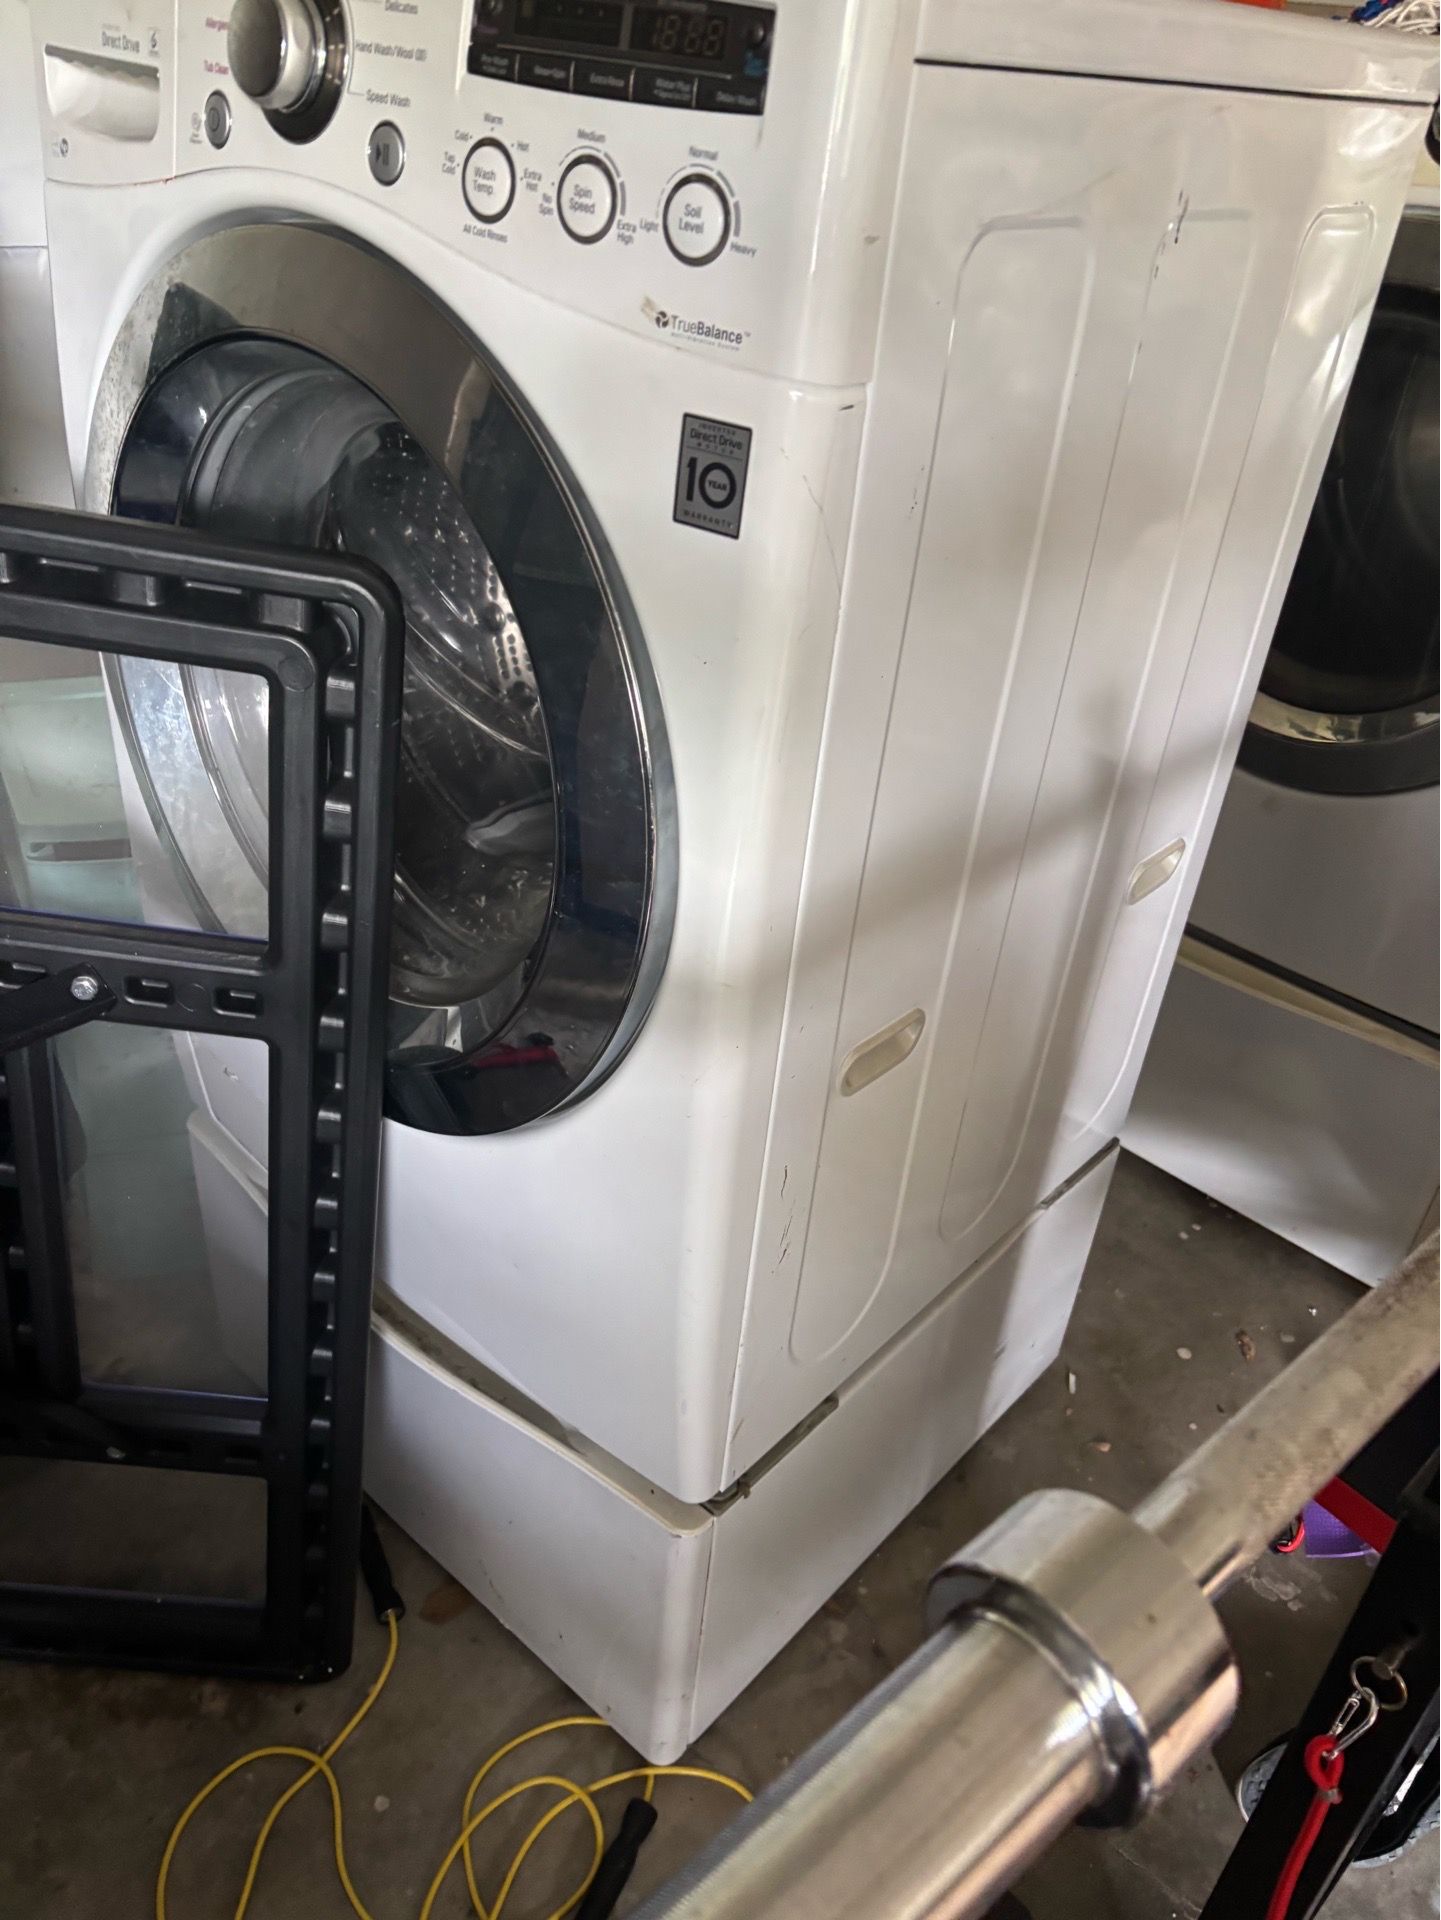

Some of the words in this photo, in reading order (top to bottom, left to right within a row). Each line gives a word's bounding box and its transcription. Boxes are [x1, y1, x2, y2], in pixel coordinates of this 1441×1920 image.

[102, 31, 122, 48] Direct
[122, 34, 140, 52] Drive
[366, 88, 389, 105] Speed
[390, 93, 411, 108] Wash
[484, 113, 503, 125] Warm
[454, 129, 469, 142] Cold
[577, 128, 606, 144] Medium
[516, 140, 529, 152] Hot
[688, 145, 718, 161] Normal
[444, 151, 456, 164] Tap
[441, 163, 456, 175] Cold
[474, 166, 497, 182] Wash
[523, 168, 542, 182] Extra
[472, 179, 494, 196] Temp
[525, 181, 539, 192] Hot
[573, 184, 593, 200] Spin
[542, 192, 553, 204] No
[568, 197, 596, 215] Speed
[538, 203, 554, 217] Spin
[684, 203, 703, 218] Soil
[462, 223, 473, 235] All
[472, 226, 487, 239] Cold
[617, 220, 637, 233] Extra
[639, 217, 660, 233] Light
[678, 218, 705, 235] Level
[616, 232, 634, 247] High
[730, 241, 758, 258] Heavy
[690, 427, 718, 444] Direct
[719, 435, 743, 450] Drive
[686, 456, 737, 510] 10
[708, 480, 727, 492] YEAR
[683, 508, 734, 527] WARRANTY
